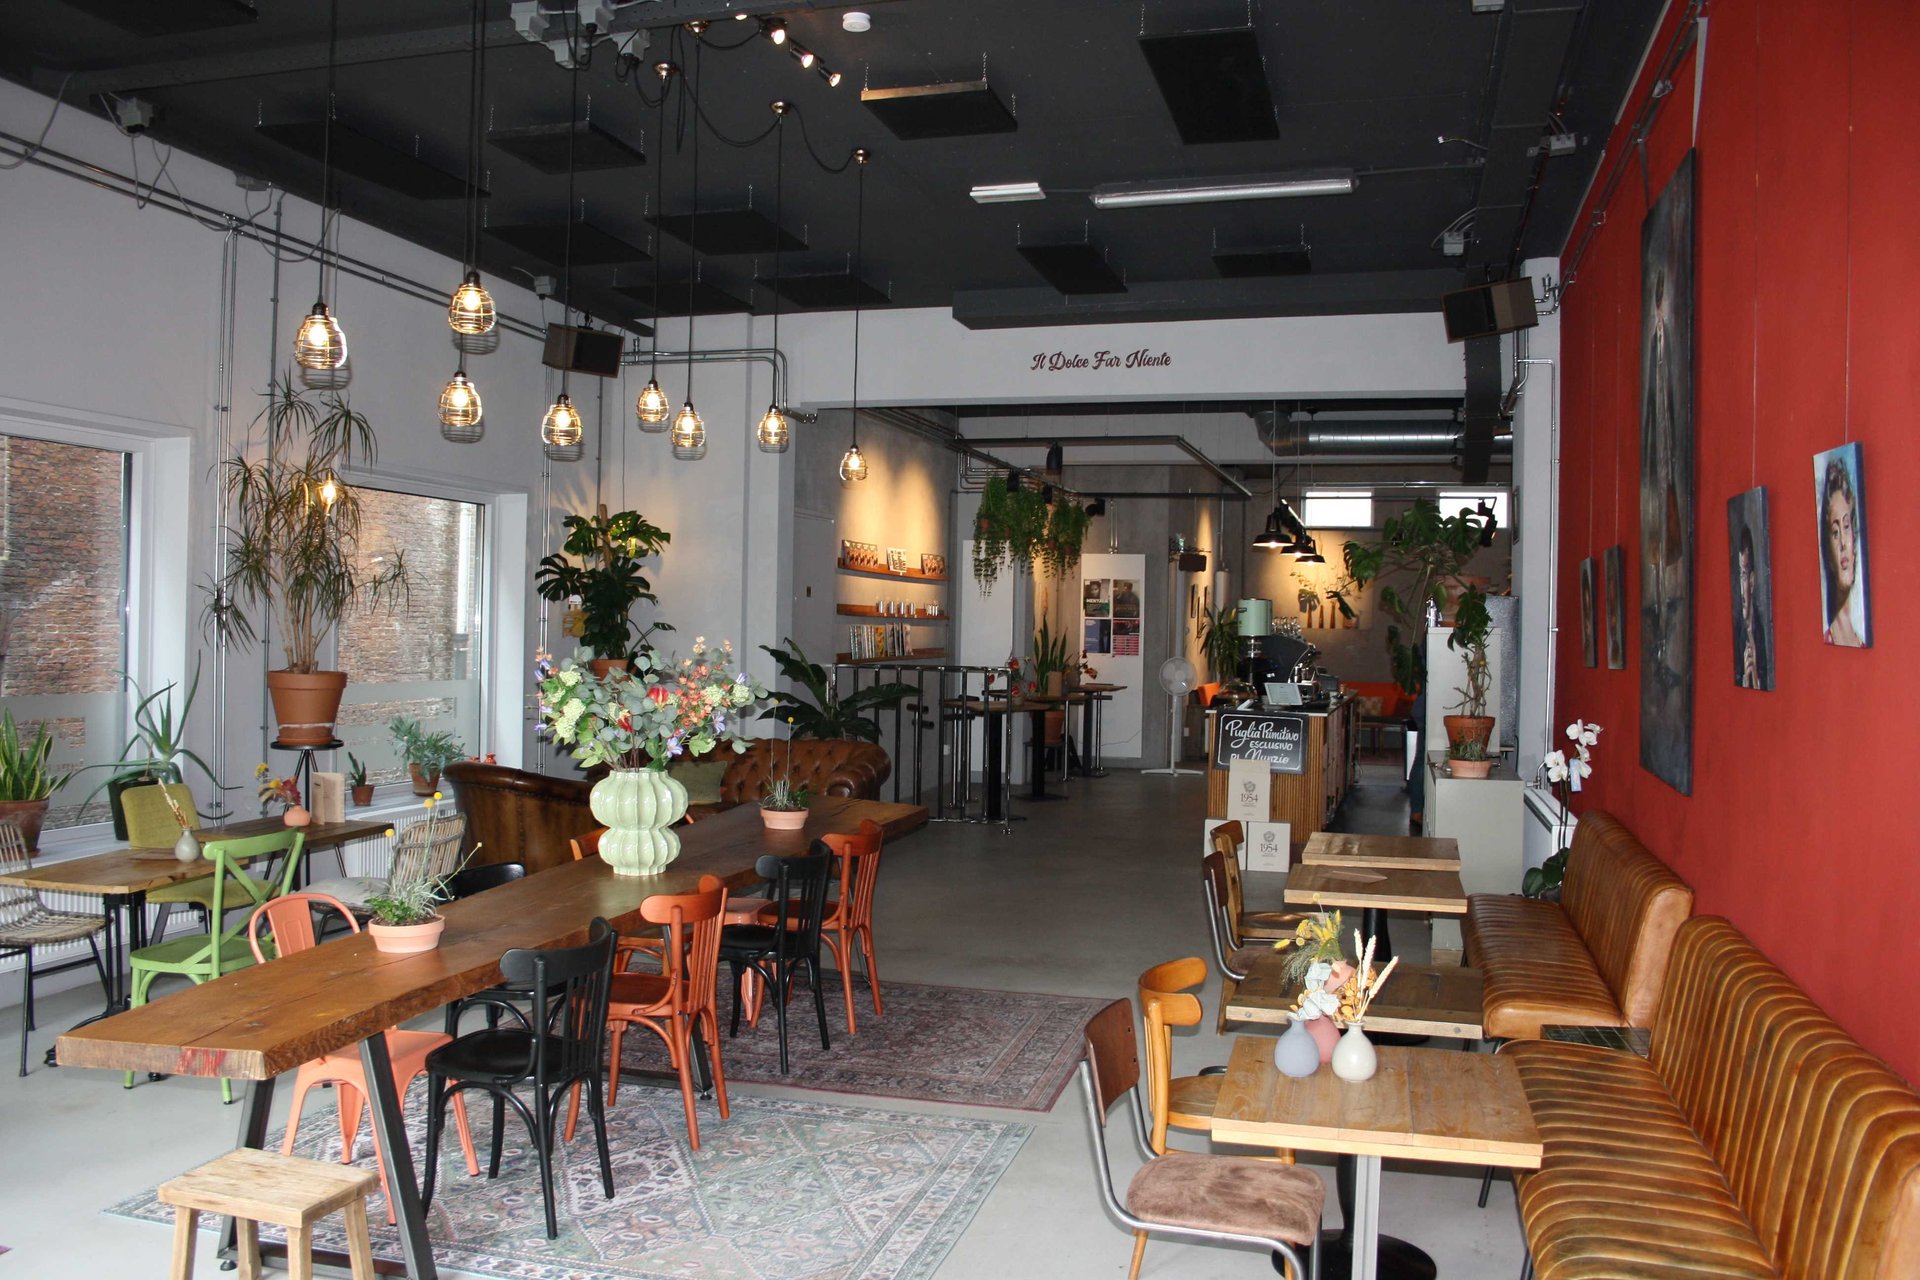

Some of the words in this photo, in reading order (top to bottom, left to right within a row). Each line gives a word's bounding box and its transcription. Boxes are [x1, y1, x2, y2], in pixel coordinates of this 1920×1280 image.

[1048, 351, 1089, 371] Dolce
[1092, 350, 1121, 370] Far
[1125, 349, 1171, 369] Niente
[1225, 720, 1260, 748] Puglia
[1249, 741, 1293, 751] ESCLUSIVO
[1240, 793, 1258, 803] 1954
[1260, 843, 1278, 853] 1954
